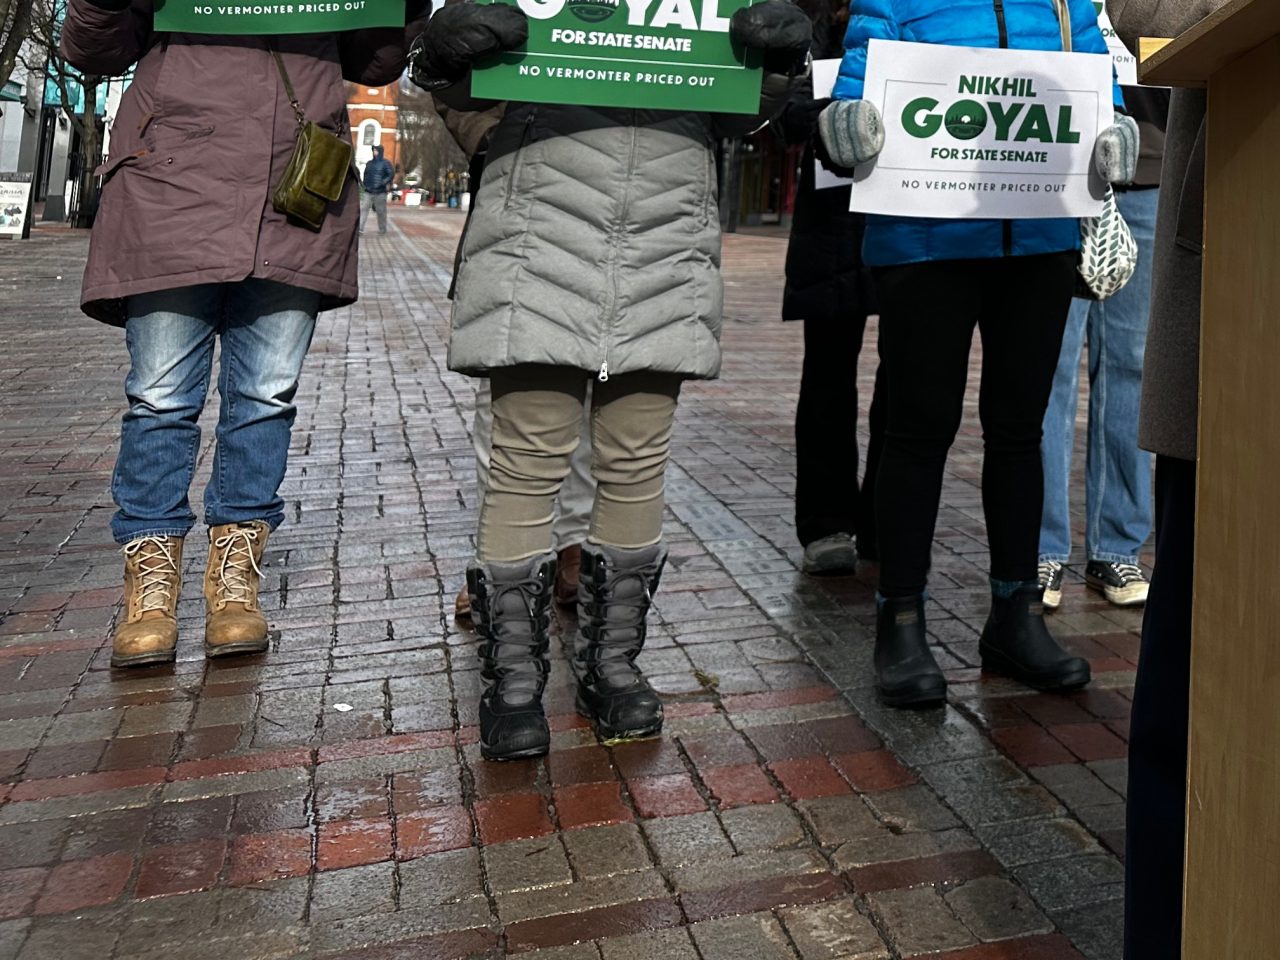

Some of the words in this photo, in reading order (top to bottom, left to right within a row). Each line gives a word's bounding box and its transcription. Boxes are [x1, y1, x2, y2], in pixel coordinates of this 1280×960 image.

[194, 5, 213, 16] NO
[217, 3, 294, 16] VERMONTER
[298, 1, 340, 14] PRICED
[344, 0, 366, 12] OUT
[551, 28, 587, 45] FOR
[587, 31, 633, 48] STATE
[633, 34, 692, 52] SENATE
[519, 65, 541, 76] NO
[546, 67, 631, 82] VERMONTER
[636, 72, 684, 85] PRICED
[688, 75, 715, 87] OUT
[957, 74, 1038, 98] NIKHIL
[900, 95, 1081, 144] GOYAL
[930, 147, 959, 160] FOR
[961, 148, 999, 162] STATE
[999, 149, 1049, 164] SENATE
[901, 179, 920, 190] NO
[925, 180, 996, 193] VERMONTER
[1000, 183, 1041, 193] PRICED
[1044, 183, 1067, 193] OUT
